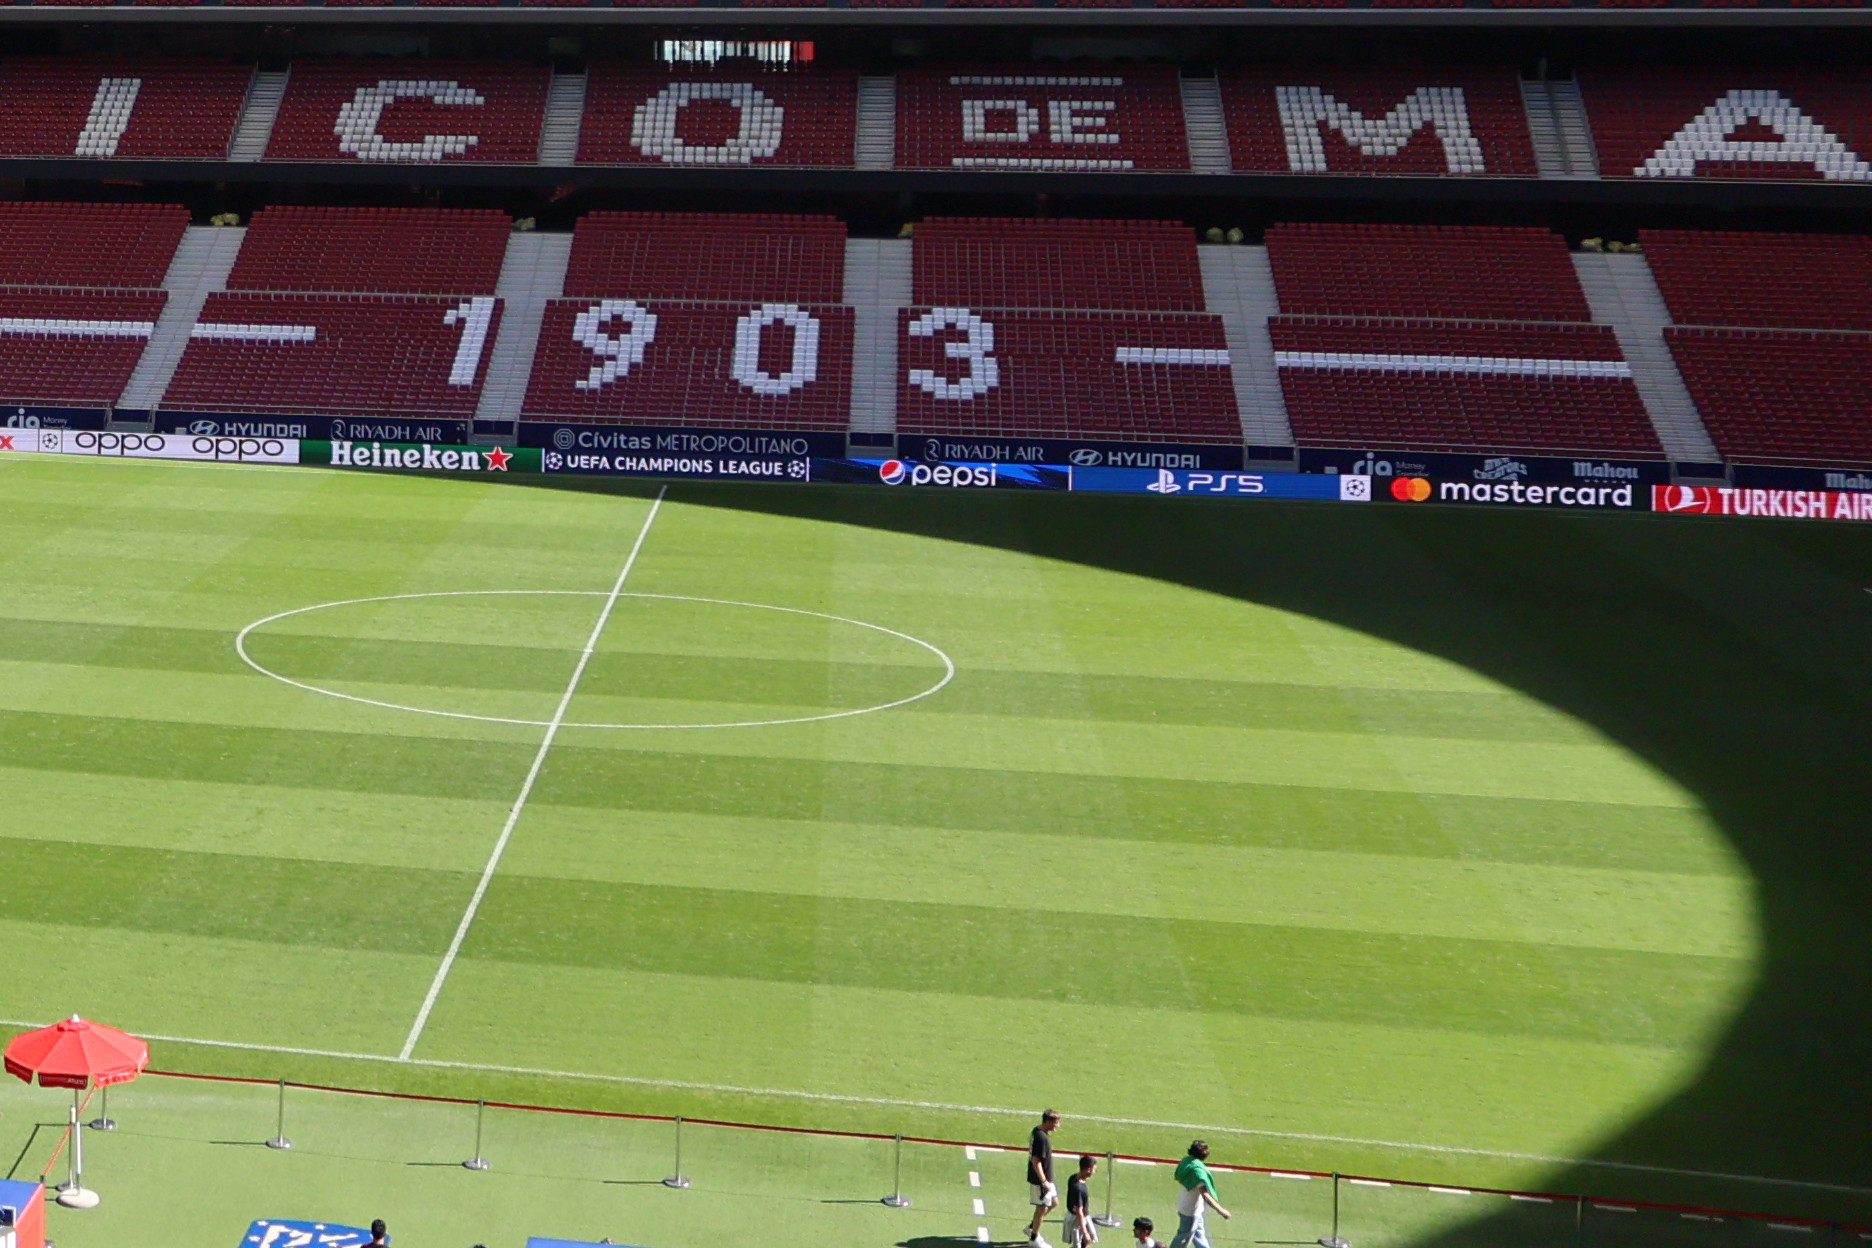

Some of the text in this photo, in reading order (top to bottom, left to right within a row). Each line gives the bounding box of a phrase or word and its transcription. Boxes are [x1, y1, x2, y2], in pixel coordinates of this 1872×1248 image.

[961, 99, 1120, 143] DE
[443, 297, 1001, 401] 1903
[7, 408, 40, 428] ria
[225, 422, 307, 438] HYUNDAI
[349, 424, 442, 441] RIYADH AIR
[75, 432, 166, 455] oppo
[192, 436, 285, 460] oppo
[578, 431, 809, 455] Cívitas METROPOLITANO
[945, 444, 1045, 461] RIYADH AIR
[330, 441, 481, 470] Heineken
[566, 455, 784, 476] UEFA CHAMPIONS LEAGUE
[1108, 452, 1201, 469] HYUNDAI
[1353, 452, 1393, 476] ria
[912, 463, 997, 488] pepsi
[1573, 461, 1640, 479] Mahou
[1188, 473, 1264, 493] PS5
[1440, 481, 1632, 507] mastercard
[1718, 488, 1827, 519] TURKISH
